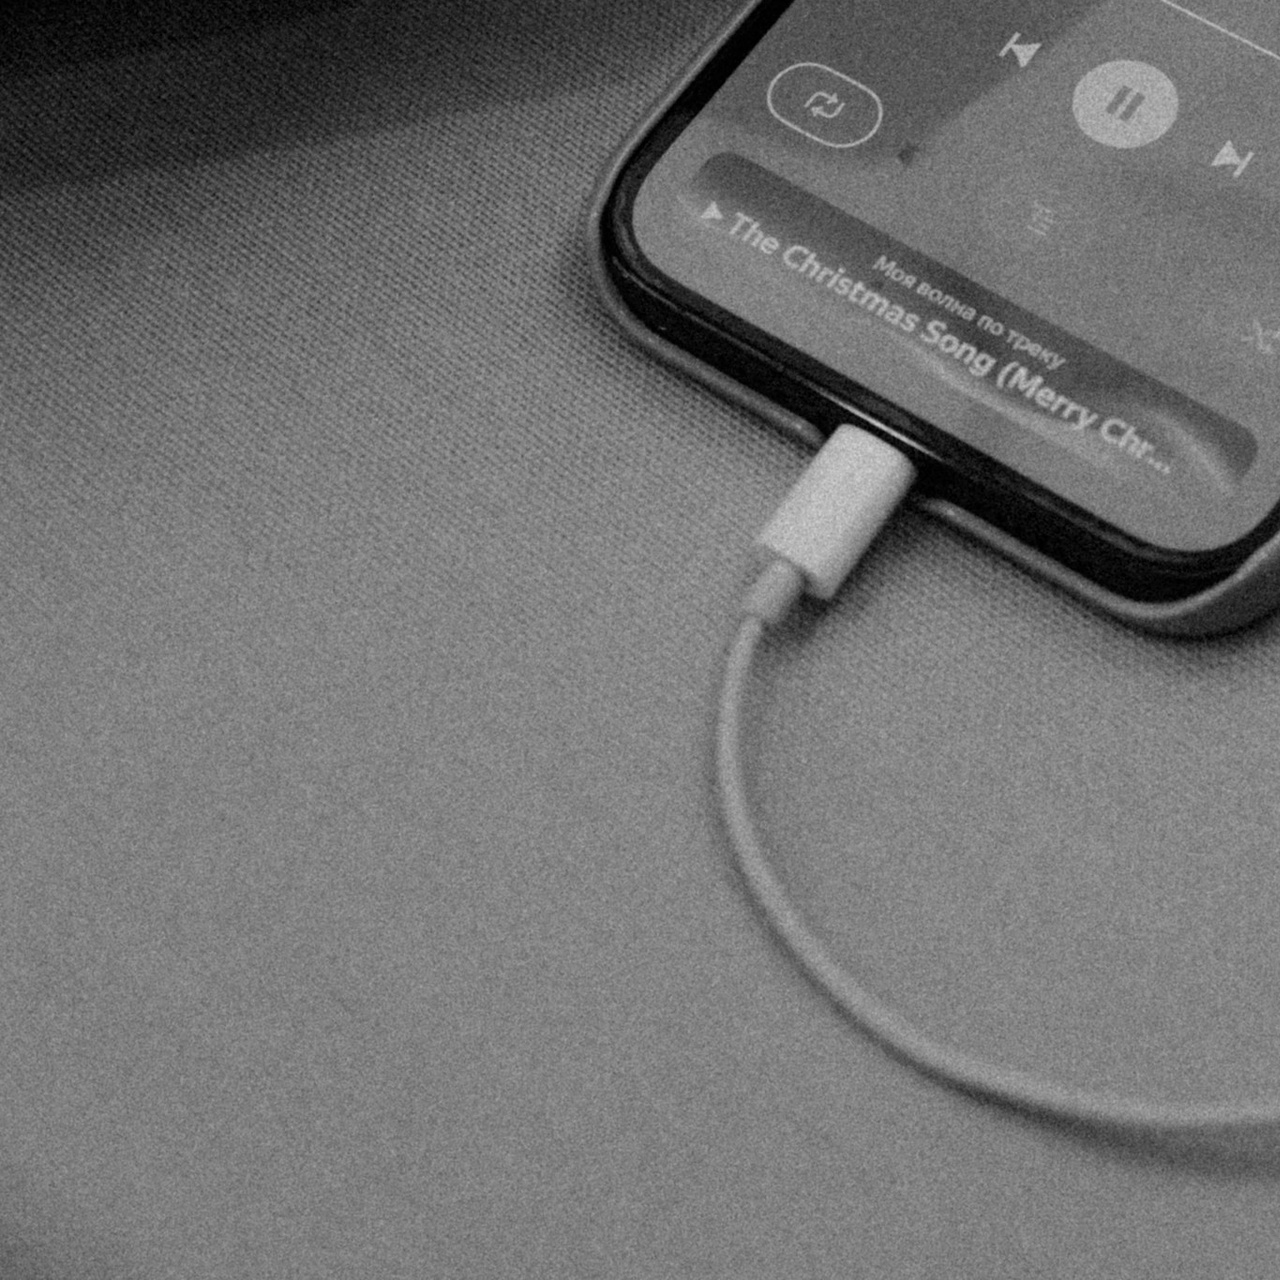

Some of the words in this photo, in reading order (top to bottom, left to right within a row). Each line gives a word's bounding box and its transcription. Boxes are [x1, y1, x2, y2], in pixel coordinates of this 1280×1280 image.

[728, 211, 780, 255] The
[782, 244, 922, 333] Christmas
[919, 319, 997, 378] Song
[996, 360, 1099, 432] (Merry
[872, 254, 917, 289] Моя
[916, 281, 977, 322] волна
[976, 314, 1005, 336] по
[1006, 329, 1067, 371] треку
